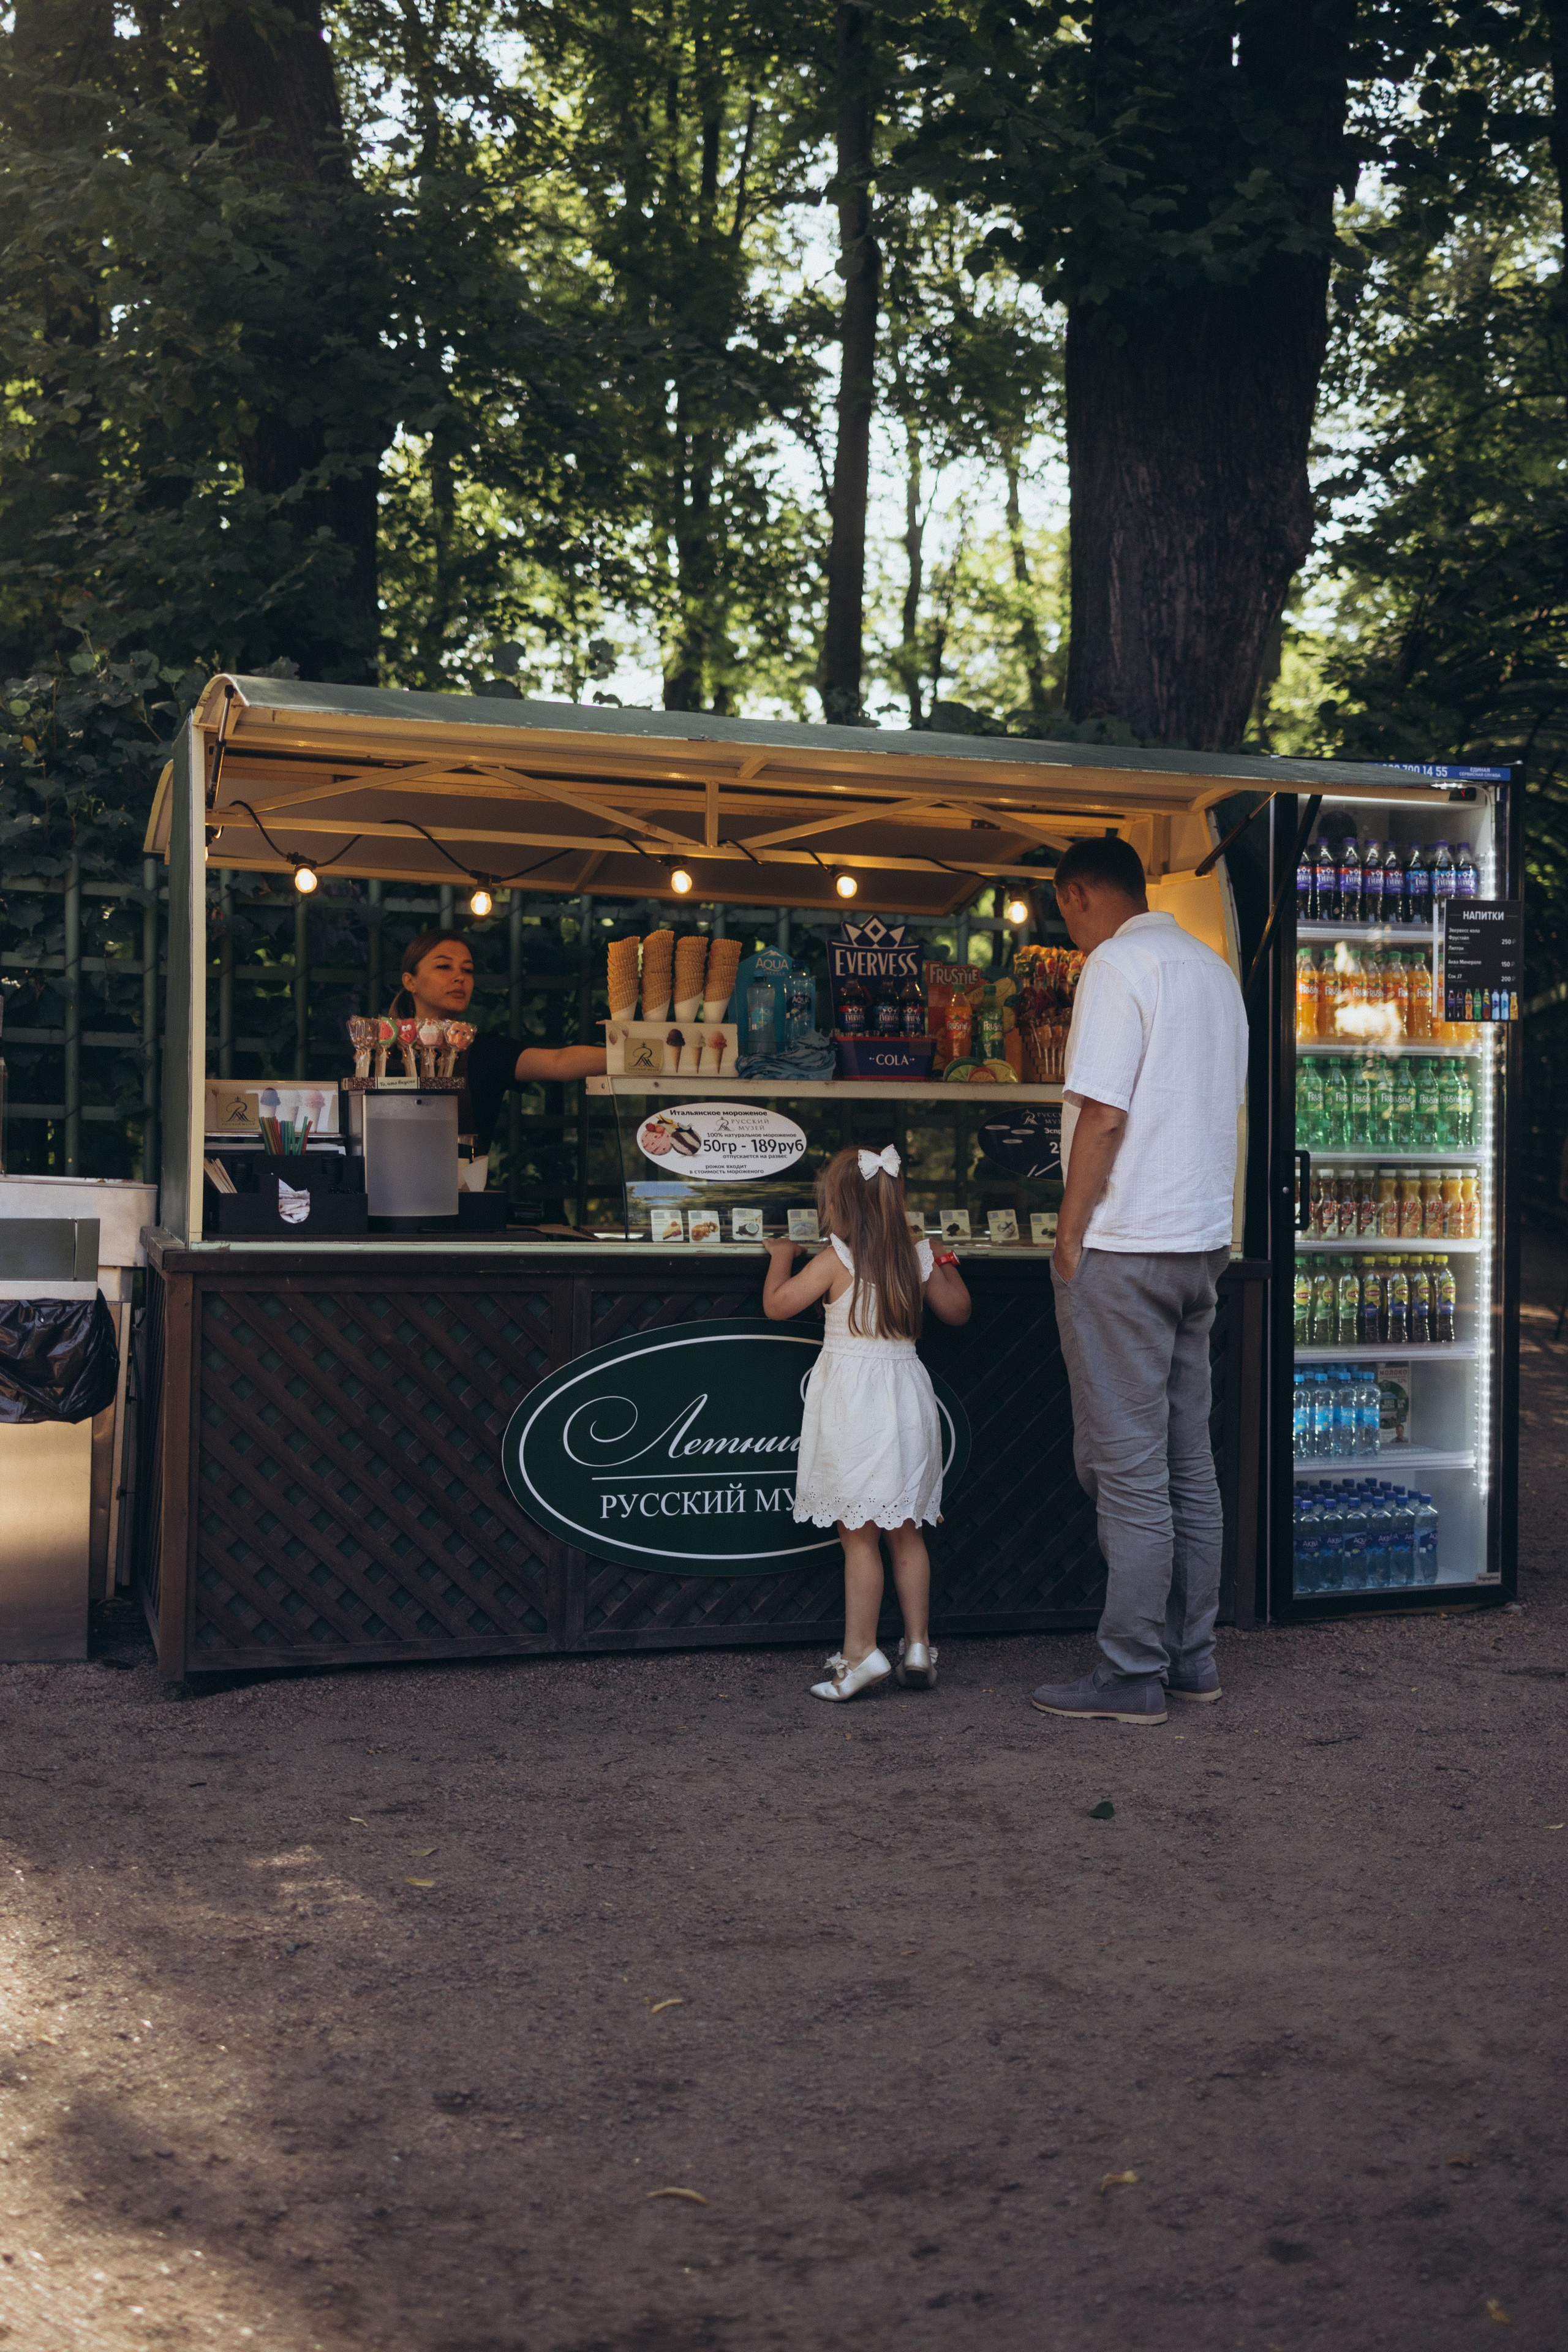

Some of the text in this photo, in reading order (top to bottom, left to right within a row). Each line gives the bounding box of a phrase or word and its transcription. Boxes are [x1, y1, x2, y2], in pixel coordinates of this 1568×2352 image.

[1423, 766, 1433, 776] 14
[1436, 766, 1447, 777] 55
[1463, 911, 1504, 921] НАПИТКИ
[755, 957, 789, 971] AQUA
[835, 949, 918, 977] EVERVESS
[876, 1054, 909, 1065] COLA
[704, 1139, 737, 1154] 50гр
[751, 1139, 804, 1155] 189руб
[1049, 1142, 1061, 1154] 2
[1401, 1202, 1416, 1213] J7
[1428, 1202, 1442, 1213] J7
[599, 1482, 747, 1519] РУССКИЙ
